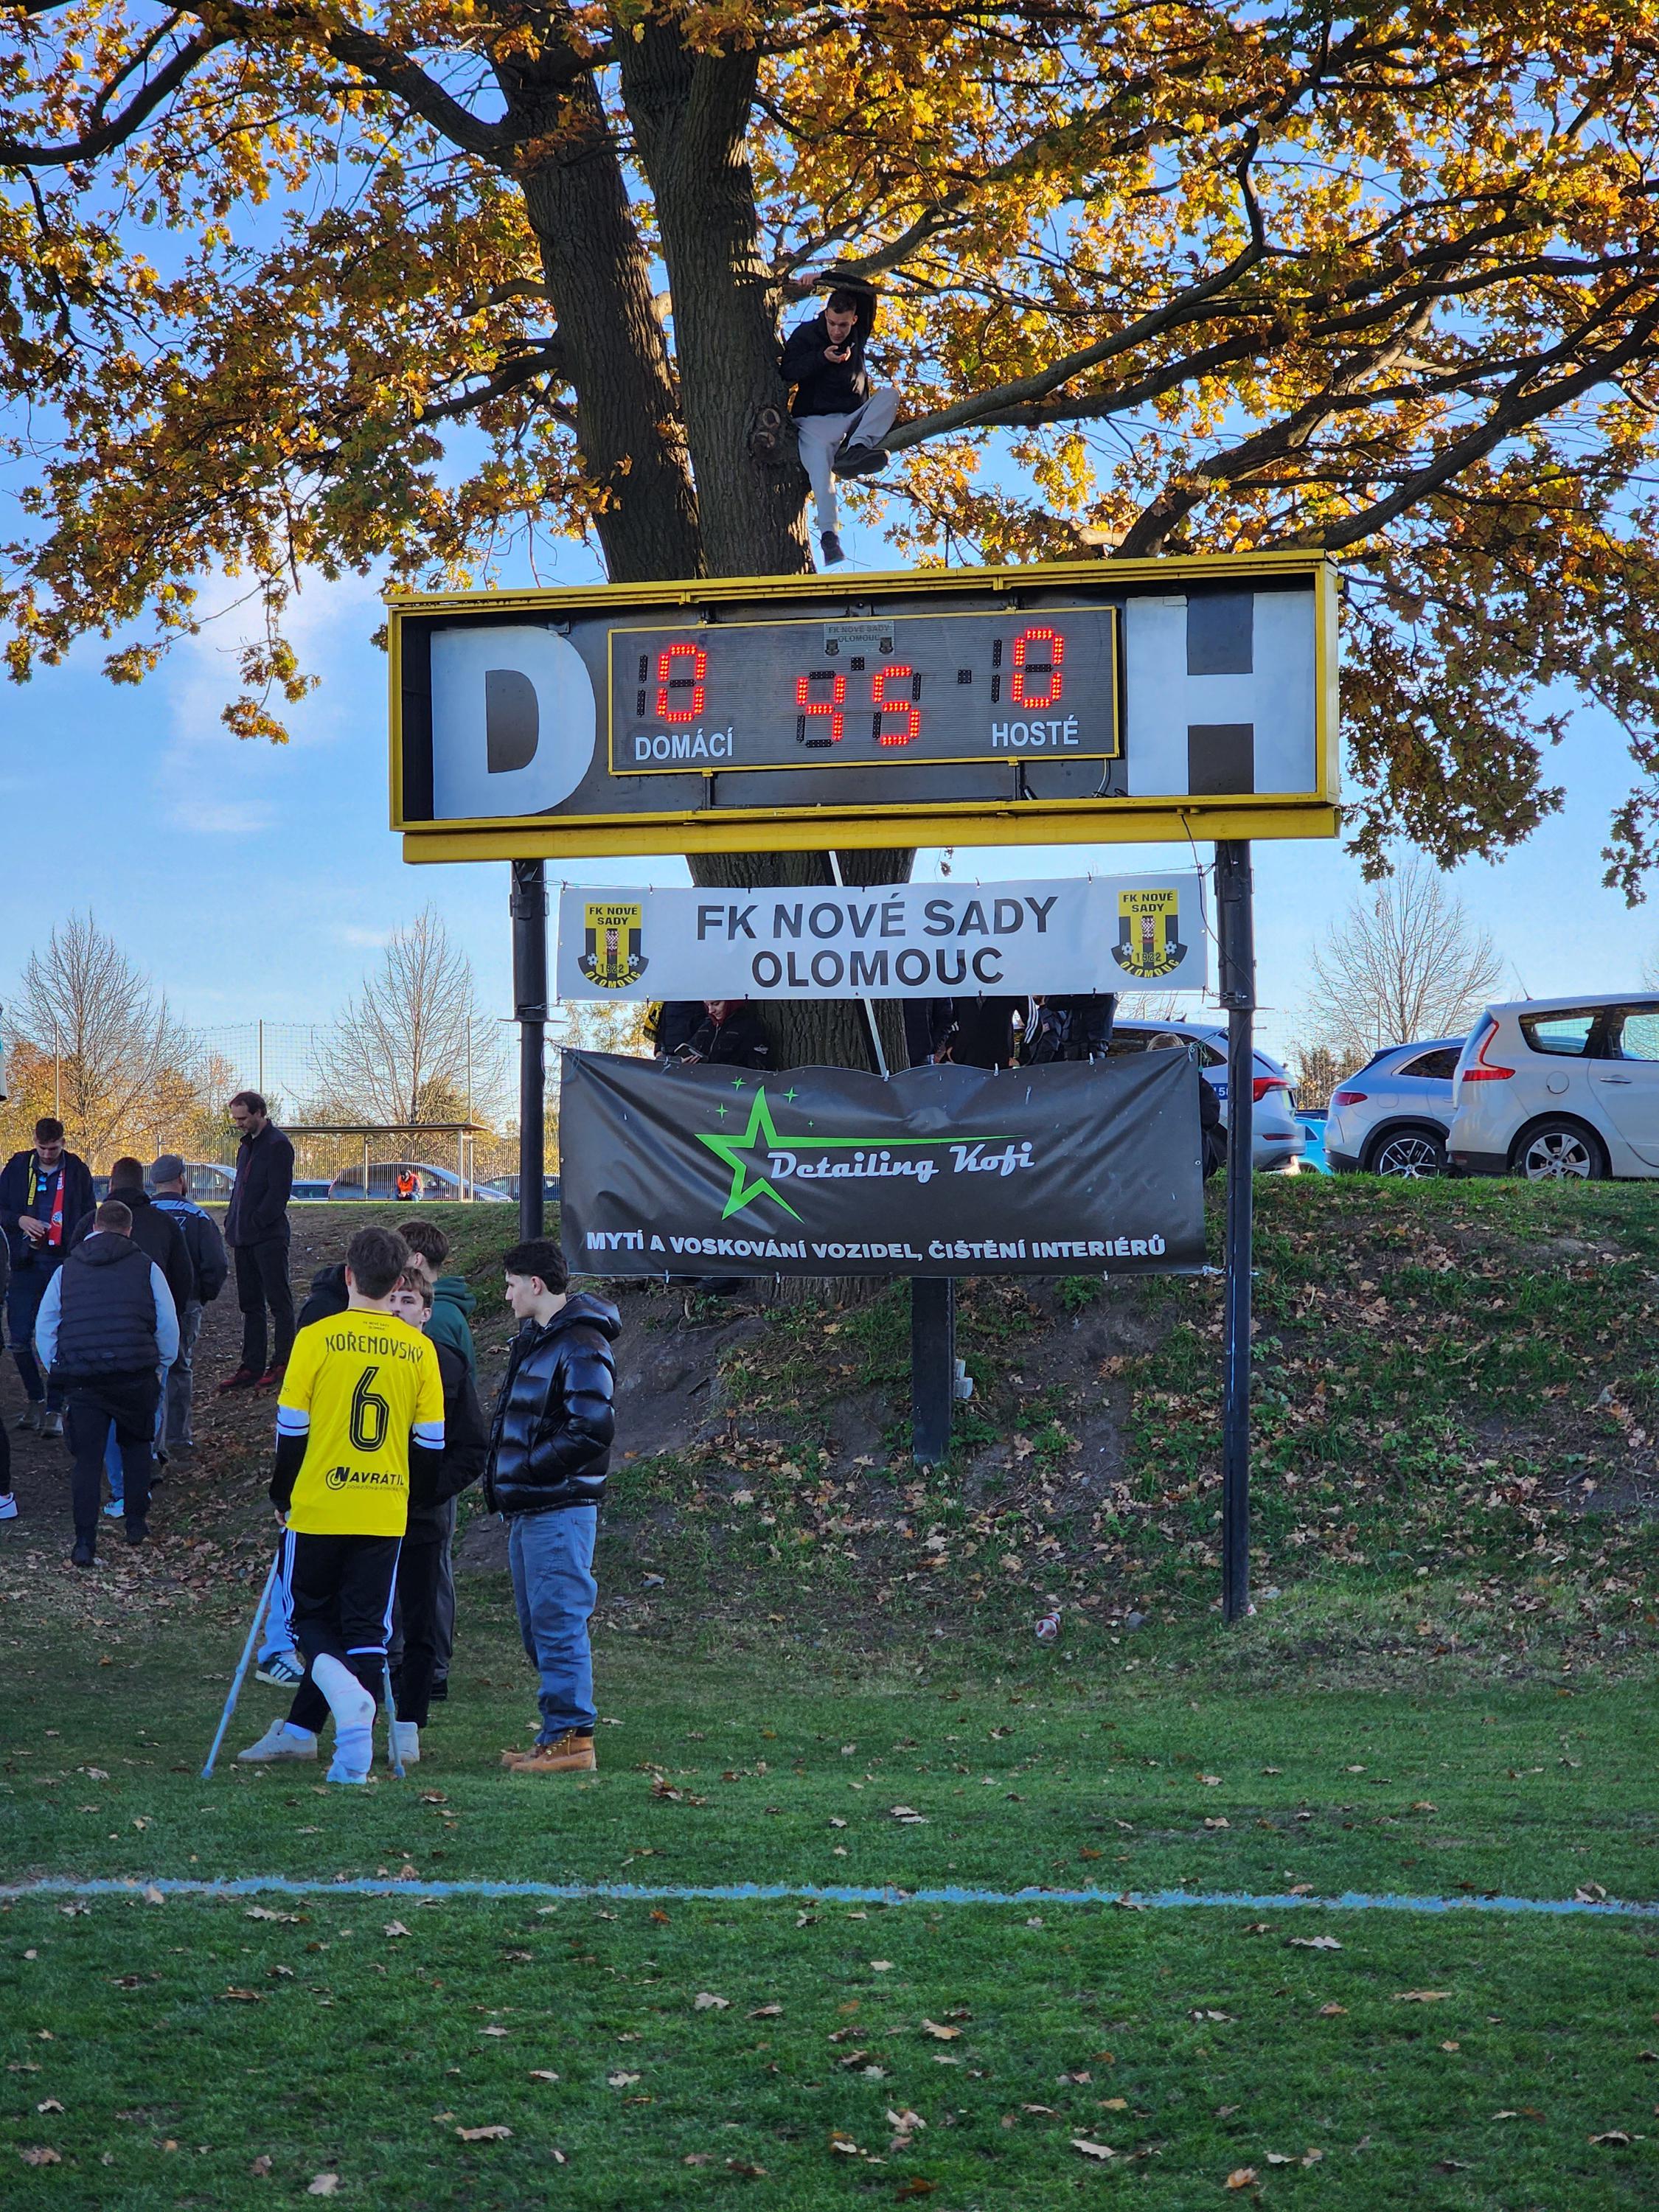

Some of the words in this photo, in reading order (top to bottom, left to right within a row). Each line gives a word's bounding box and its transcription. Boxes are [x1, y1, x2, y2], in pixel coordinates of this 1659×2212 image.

[838, 634, 880, 643] OLOMOUC
[1127, 590, 1317, 796] H
[797, 666, 920, 747] 45
[431, 625, 596, 820] D
[992, 714, 1079, 747] HOSTÉ
[635, 726, 734, 760] DOMÁCÍ
[589, 906, 603, 915] FK
[607, 905, 638, 915] NOVÉ
[1122, 894, 1137, 903] FK
[1142, 891, 1174, 902] NOVÉ
[1132, 903, 1164, 913] SADY
[597, 917, 629, 925] SADY
[697, 904, 759, 941] FK
[773, 892, 906, 939] NOVÉ
[922, 896, 1060, 936] SADY
[599, 963, 625, 973] 1922
[751, 947, 1004, 989] OLOMOUC
[1120, 959, 1180, 978] OLOMOUC
[1135, 952, 1161, 963] 1922
[585, 970, 641, 988] OLOMOUC
[767, 1150, 939, 1183] Detailing
[949, 1141, 1034, 1177] Kofi
[586, 1229, 644, 1251] MYTÍ
[650, 1235, 666, 1252] A
[669, 1237, 807, 1259] VOSKOVÁNÍ
[812, 1242, 923, 1262] VOZIDEL,
[928, 1239, 1026, 1259] ČIŠTĚNÍ
[1032, 1233, 1166, 1259] INTERIÉRŮ
[349, 1366, 390, 1453] 6
[335, 1466, 404, 1486] NAVRÁTIL
